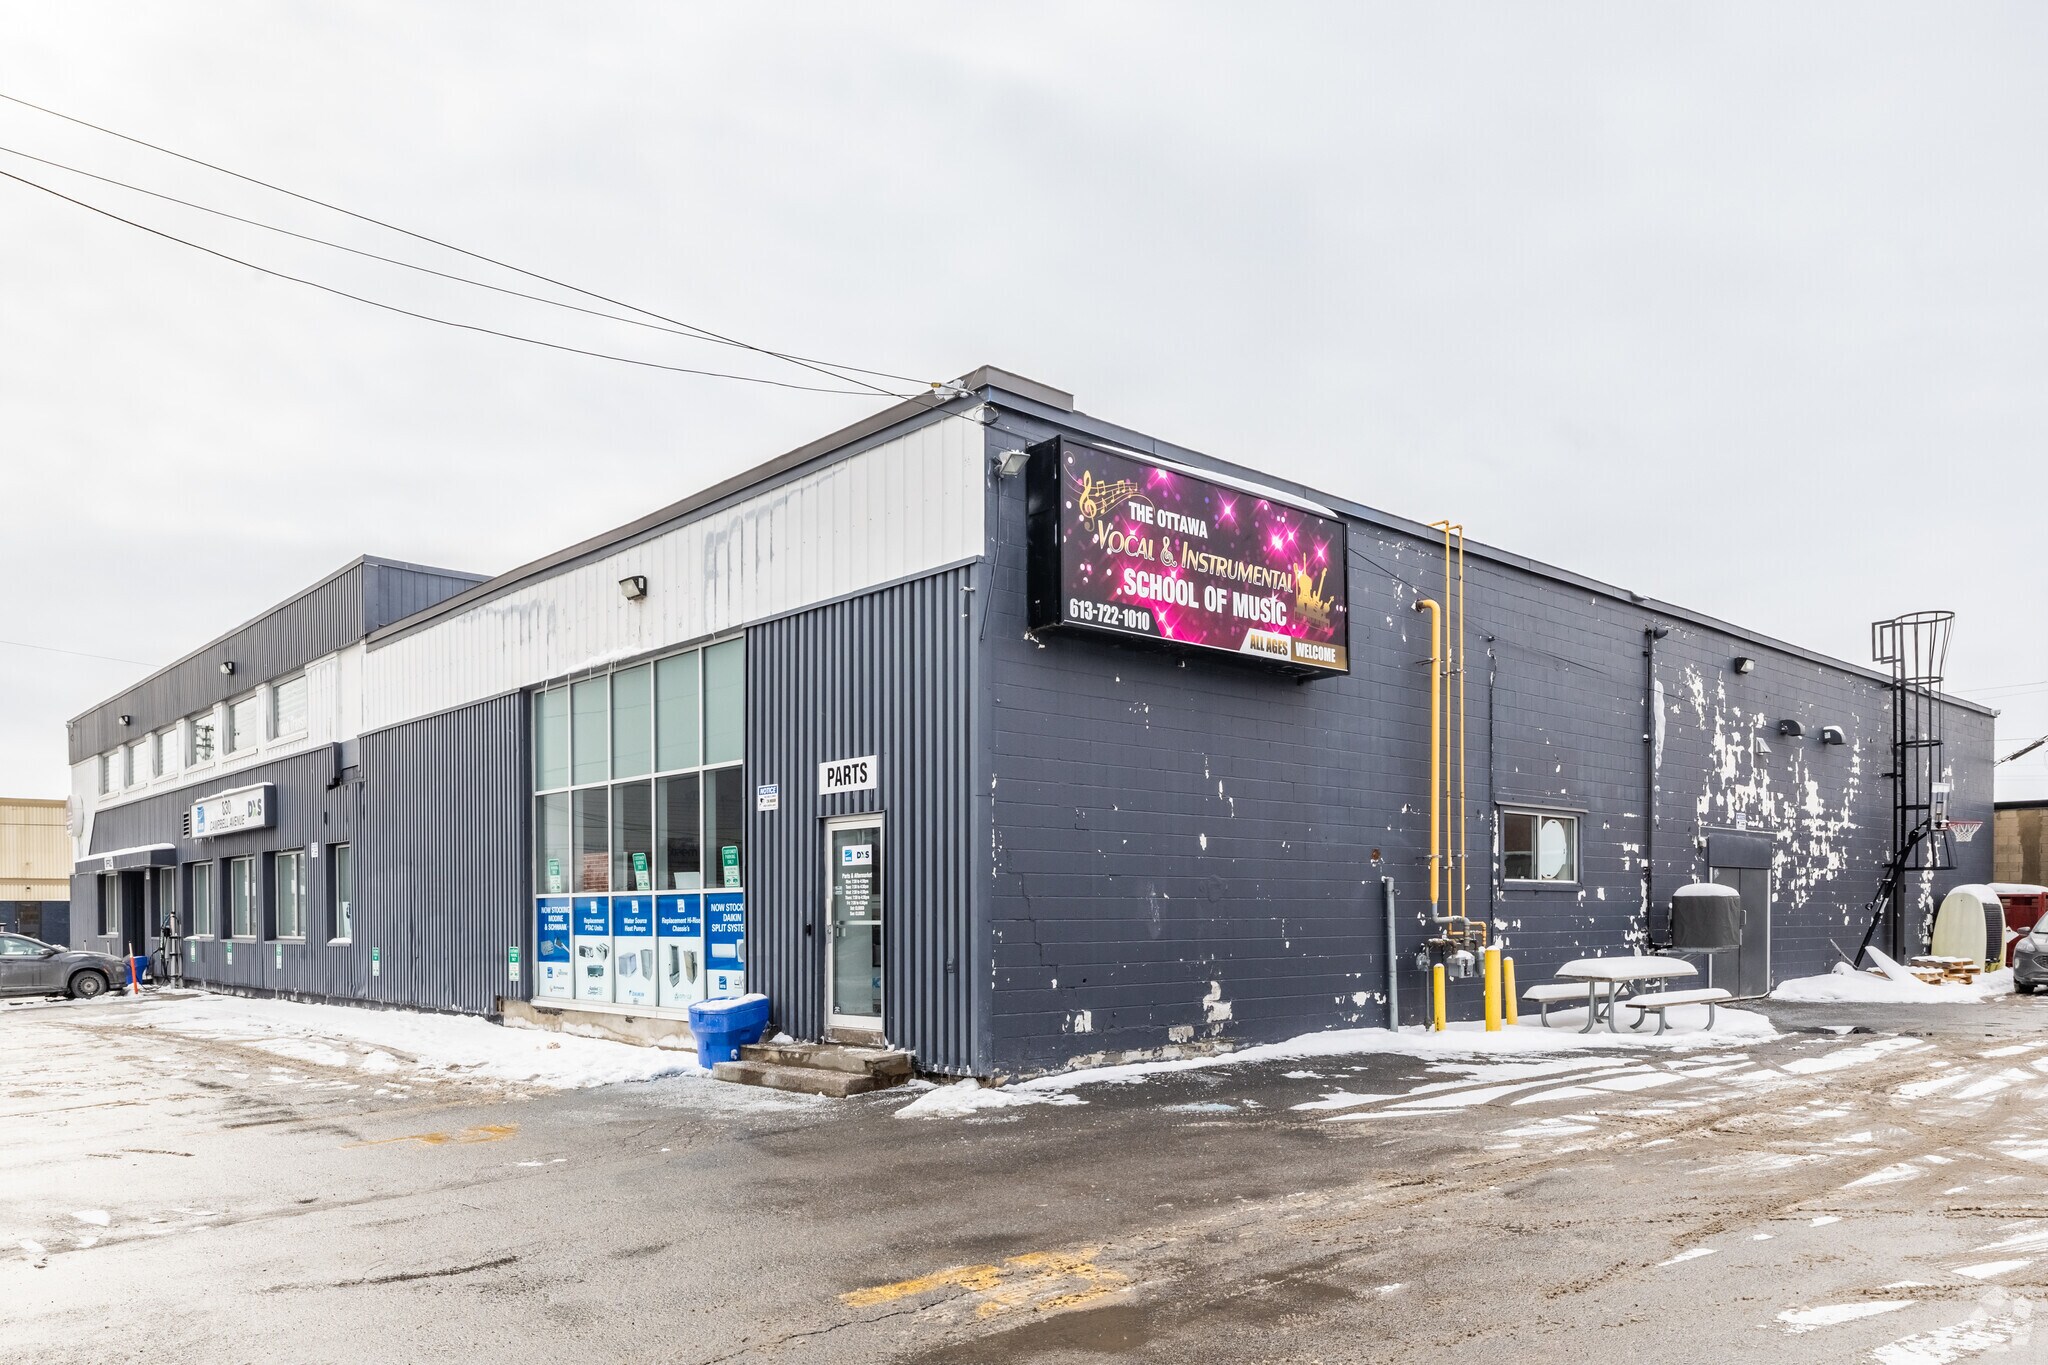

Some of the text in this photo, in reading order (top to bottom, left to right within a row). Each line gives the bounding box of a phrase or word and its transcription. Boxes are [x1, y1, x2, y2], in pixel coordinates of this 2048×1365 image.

[1128, 501, 1208, 539] THE OTTAWA
[1097, 519, 1293, 593] VOCAL & INSTRUMENTAL
[1123, 567, 1287, 627] SCHOOL OF MUSIC
[1069, 597, 1150, 631] 613-722-1010
[1250, 634, 1336, 663] ALL AGES WELCOME
[827, 761, 868, 788] PARTS
[759, 785, 777, 795] NOTICE
[541, 906, 551, 914] NOW
[710, 903, 744, 912] NOW STOCK
[583, 917, 605, 925] Replacement
[661, 917, 686, 925] Replacement
[722, 913, 742, 922] DAIKIN
[711, 923, 744, 932] SPLIT SYSTE
